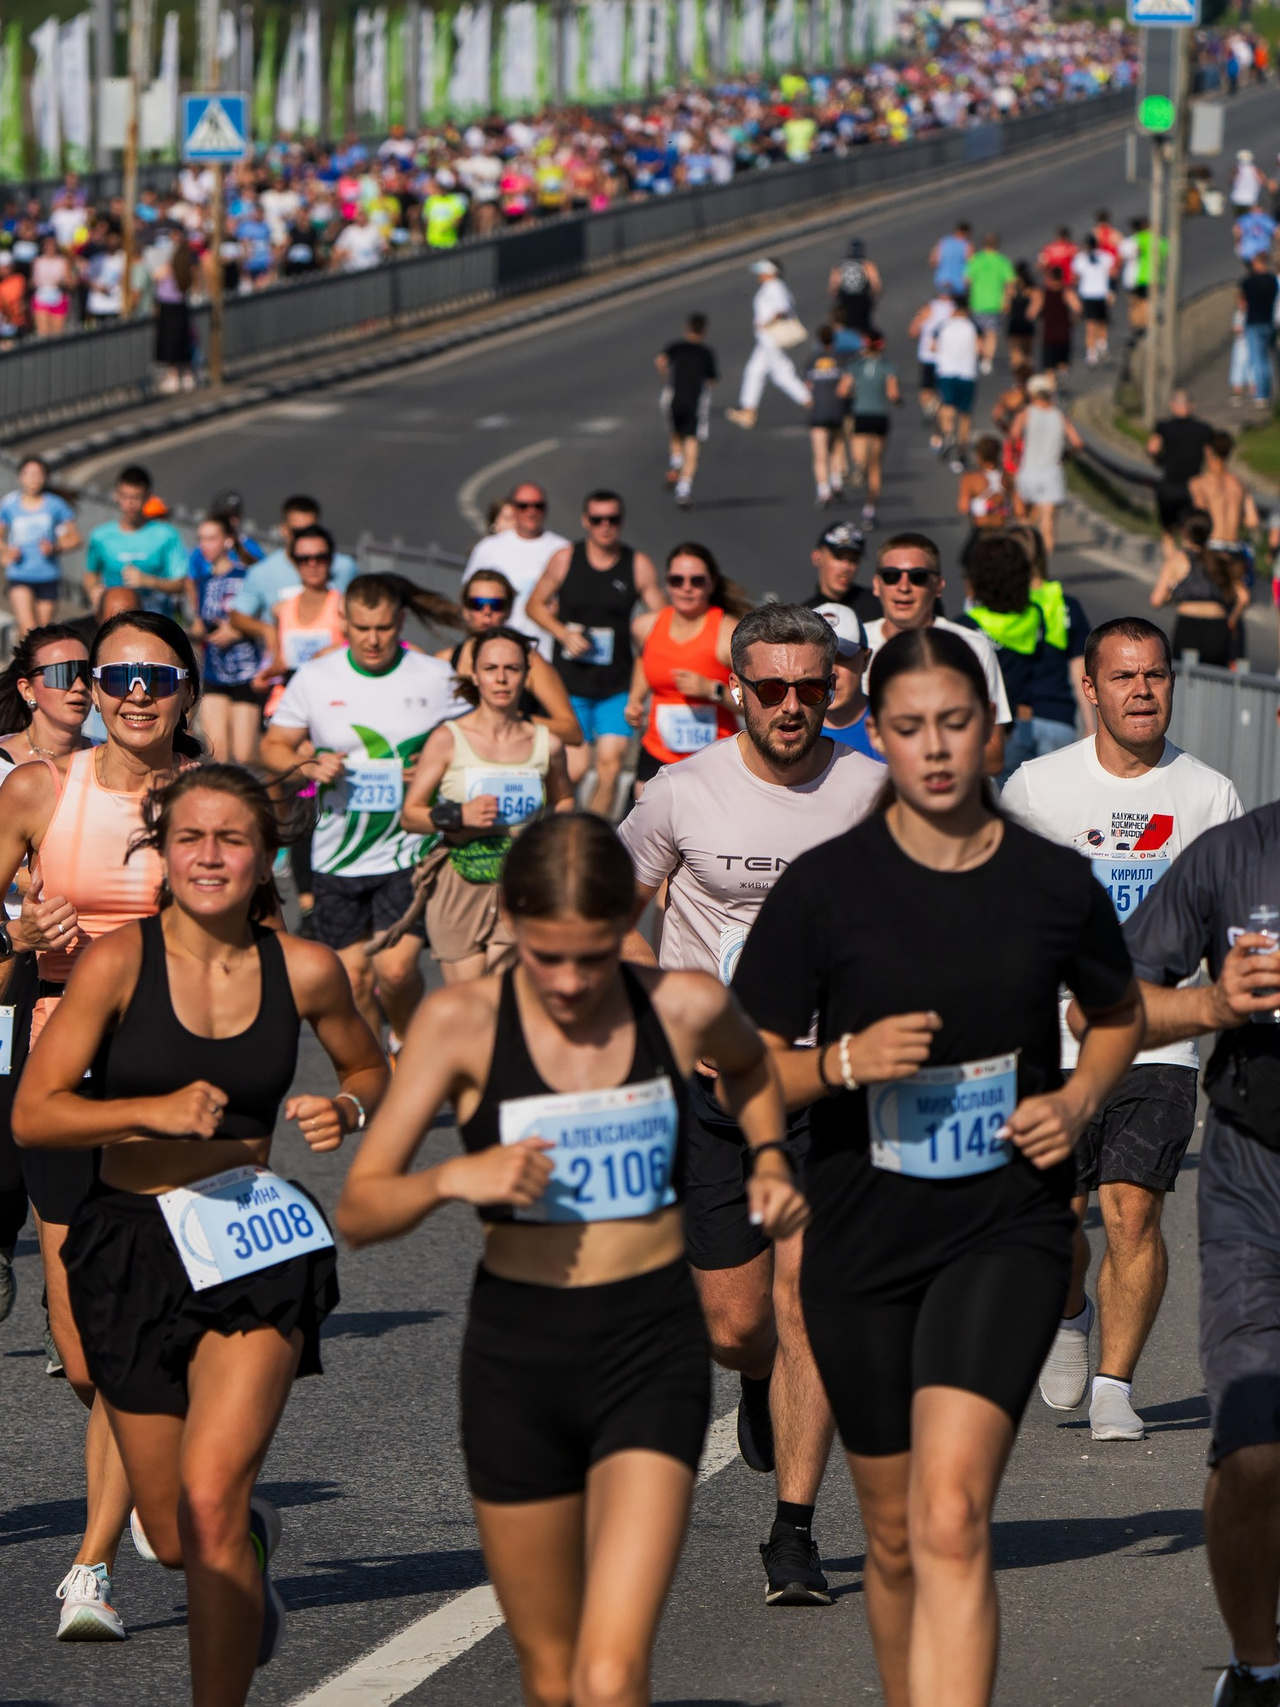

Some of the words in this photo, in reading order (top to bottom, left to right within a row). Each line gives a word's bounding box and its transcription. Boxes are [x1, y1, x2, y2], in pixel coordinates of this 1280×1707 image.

[354, 785, 396, 806] 2373
[1111, 812, 1149, 822] КАЛУЖСКИЙ
[1111, 821, 1157, 831] КОСМИЧЕСКИЙ
[1111, 868, 1153, 881] КИРИЛЛ
[924, 1112, 1006, 1164] 1142
[570, 1146, 668, 1204] 2106
[236, 1186, 281, 1212] АРИНА
[226, 1203, 314, 1260] 3008
